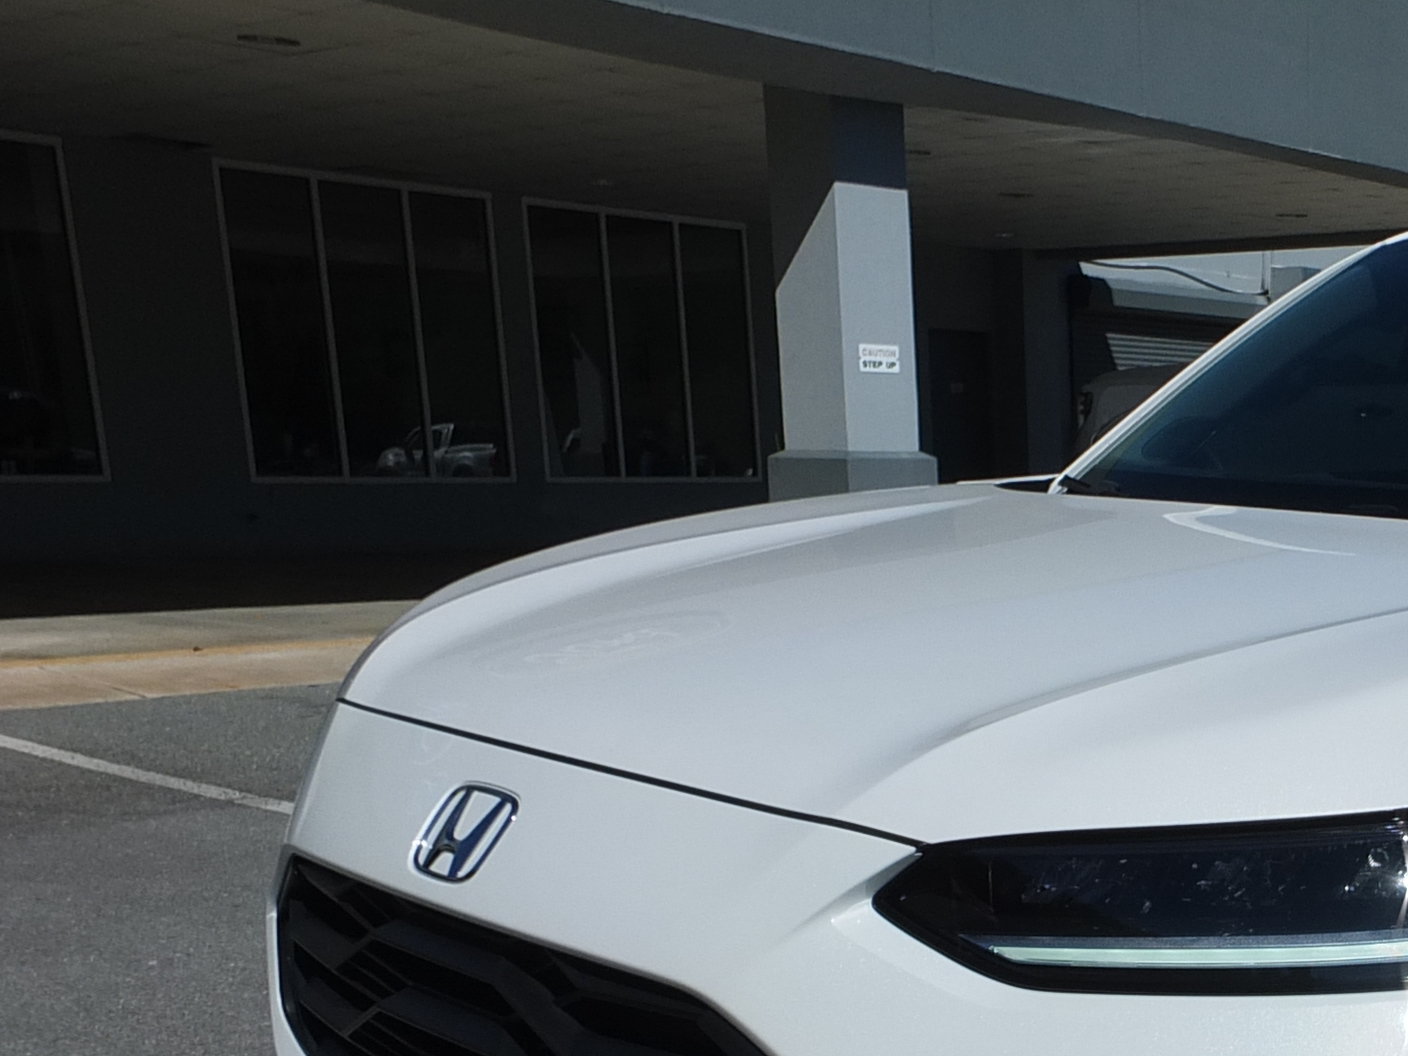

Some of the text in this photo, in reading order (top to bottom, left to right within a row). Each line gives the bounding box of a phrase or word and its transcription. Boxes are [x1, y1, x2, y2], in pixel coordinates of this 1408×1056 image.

[862, 348, 896, 358] CAUTION
[862, 360, 896, 369] STEP UP
